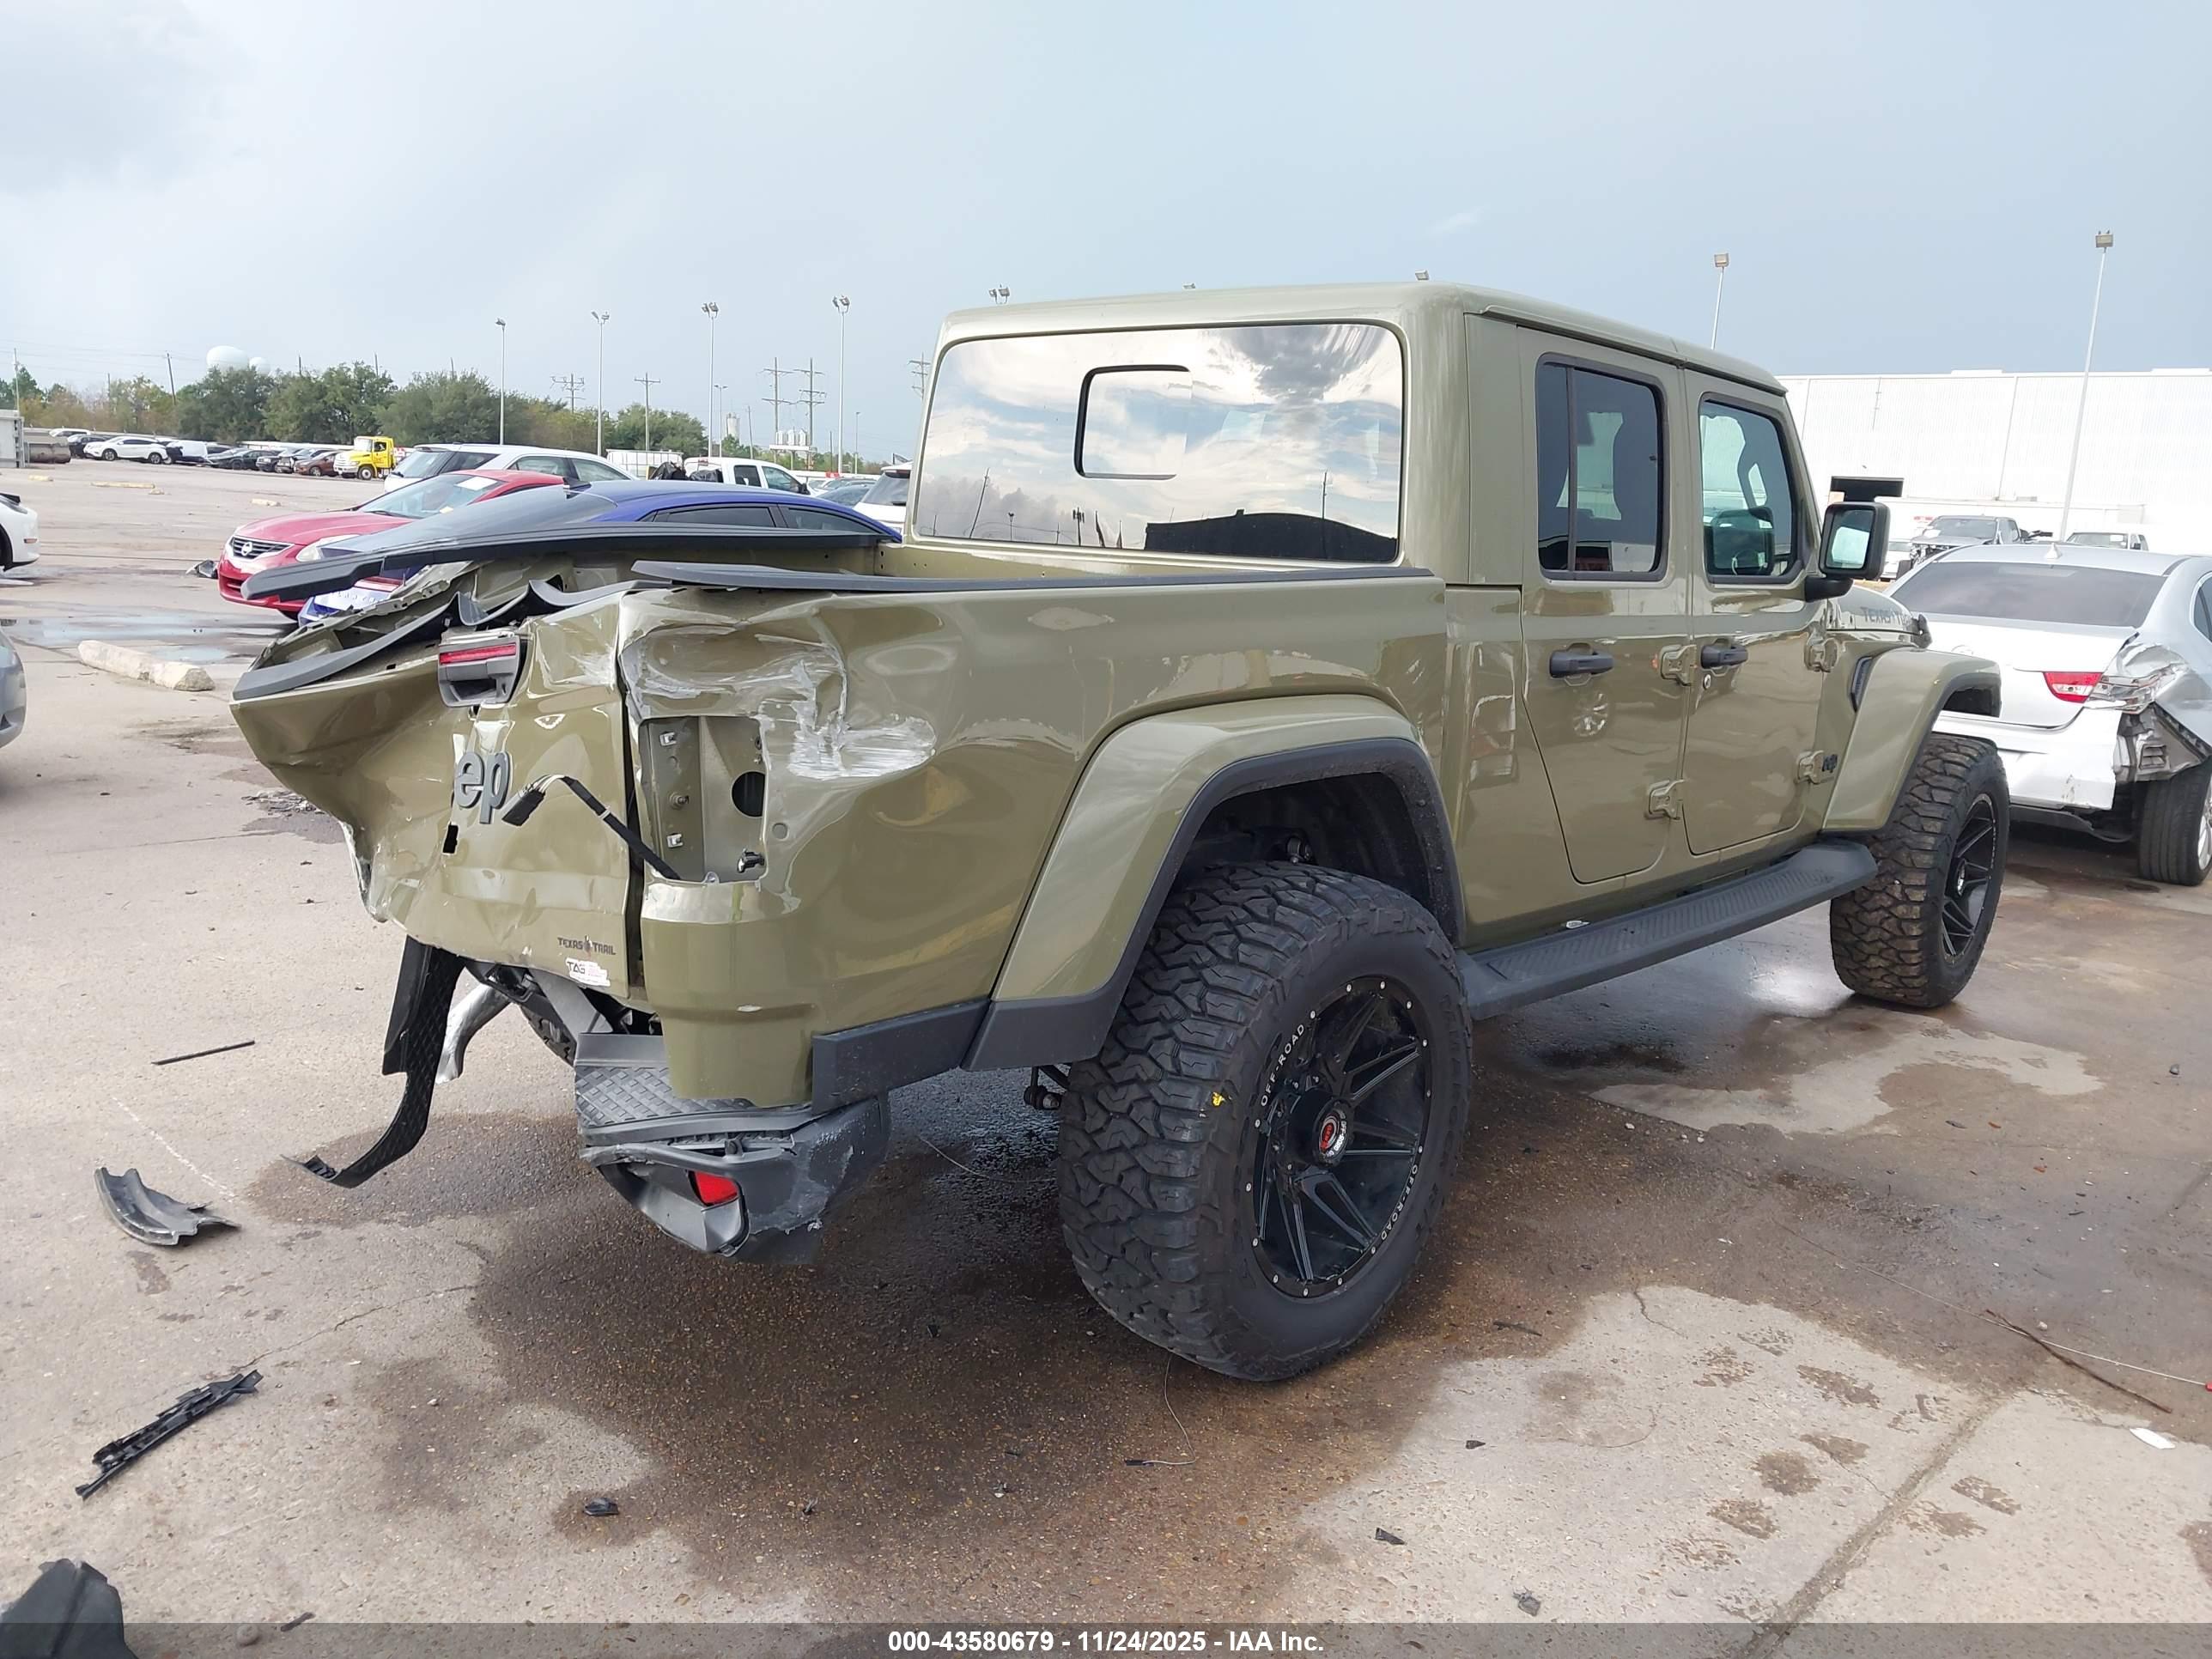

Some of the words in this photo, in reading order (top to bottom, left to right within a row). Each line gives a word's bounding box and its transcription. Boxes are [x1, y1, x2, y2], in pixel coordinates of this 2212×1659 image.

[557, 937, 583, 950] TEXAS
[592, 941, 617, 955] TRAIL
[567, 961, 586, 975] TAG
[1261, 1024, 1304, 1107] OFF-ROAD
[1381, 1164, 1419, 1241] OFF-ROAD
